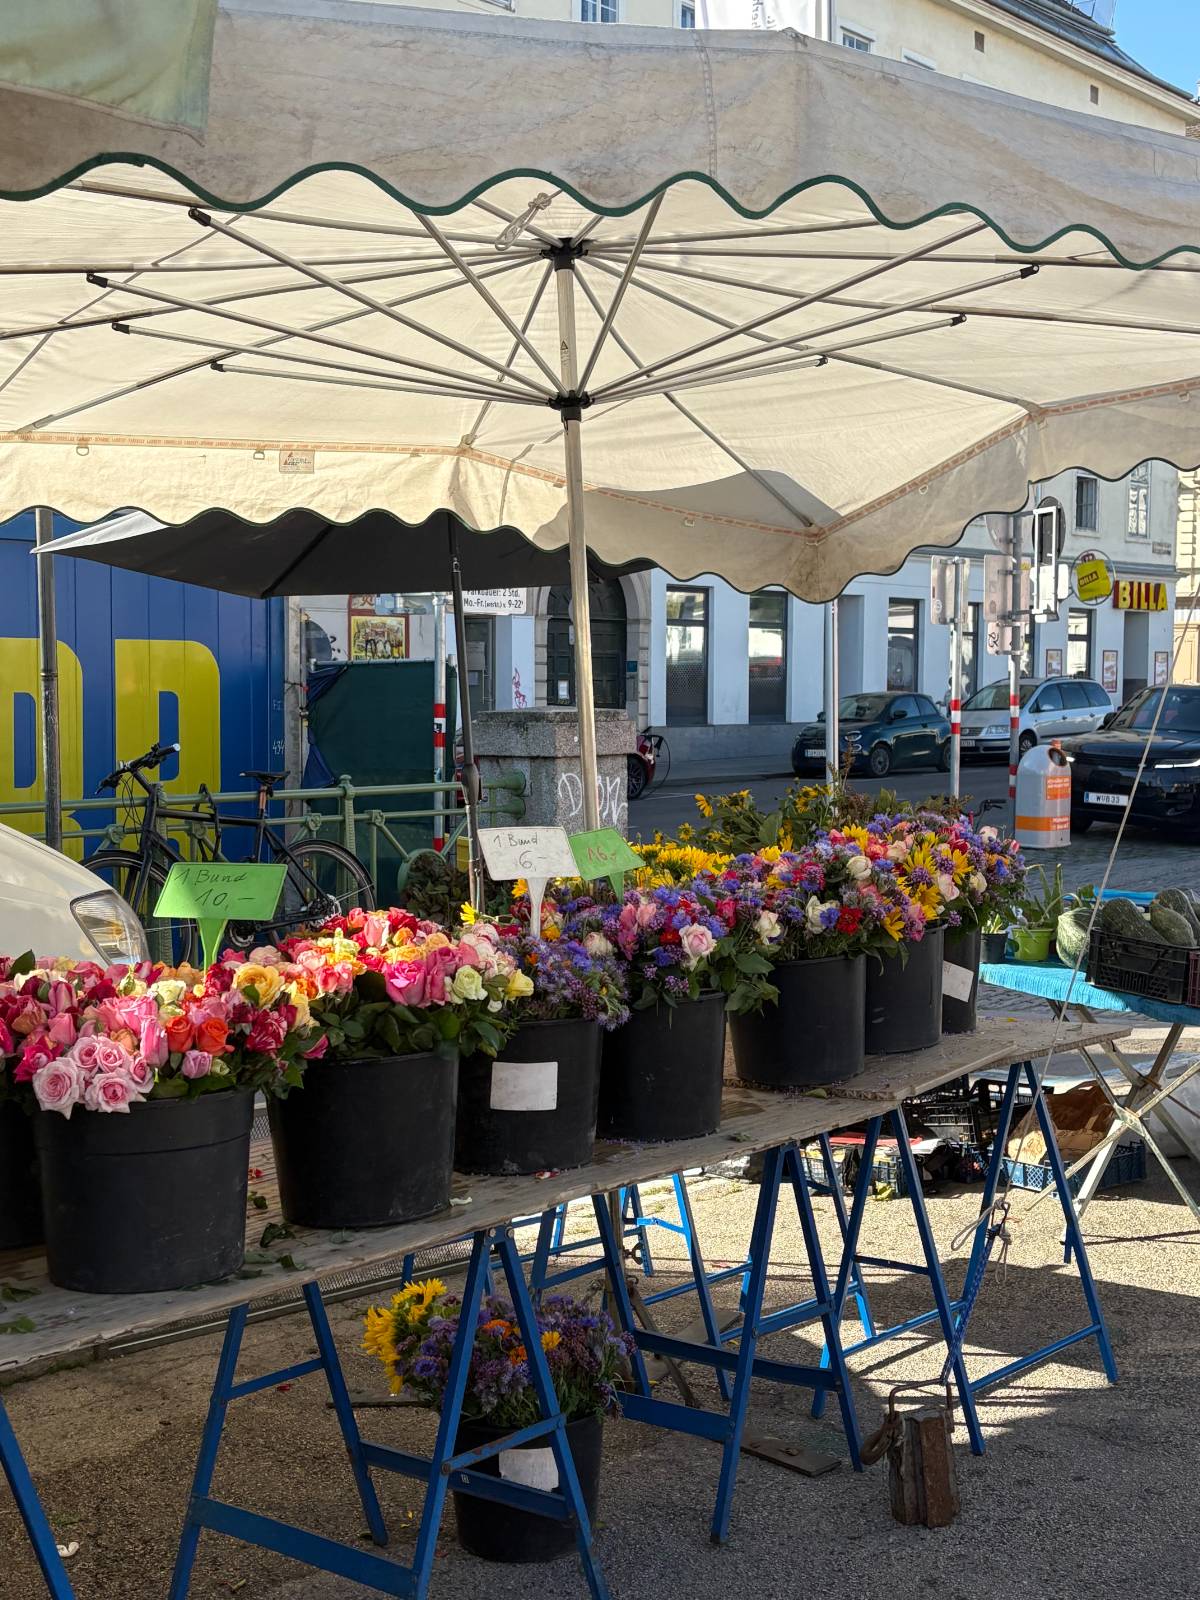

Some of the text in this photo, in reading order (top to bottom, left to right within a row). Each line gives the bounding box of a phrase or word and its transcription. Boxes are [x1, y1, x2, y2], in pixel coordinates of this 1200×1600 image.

[1079, 571, 1098, 586] BILLA
[1118, 581, 1168, 611] BILLA
[493, 832, 538, 848] 1 Bund
[174, 868, 248, 886] 1 Bund
